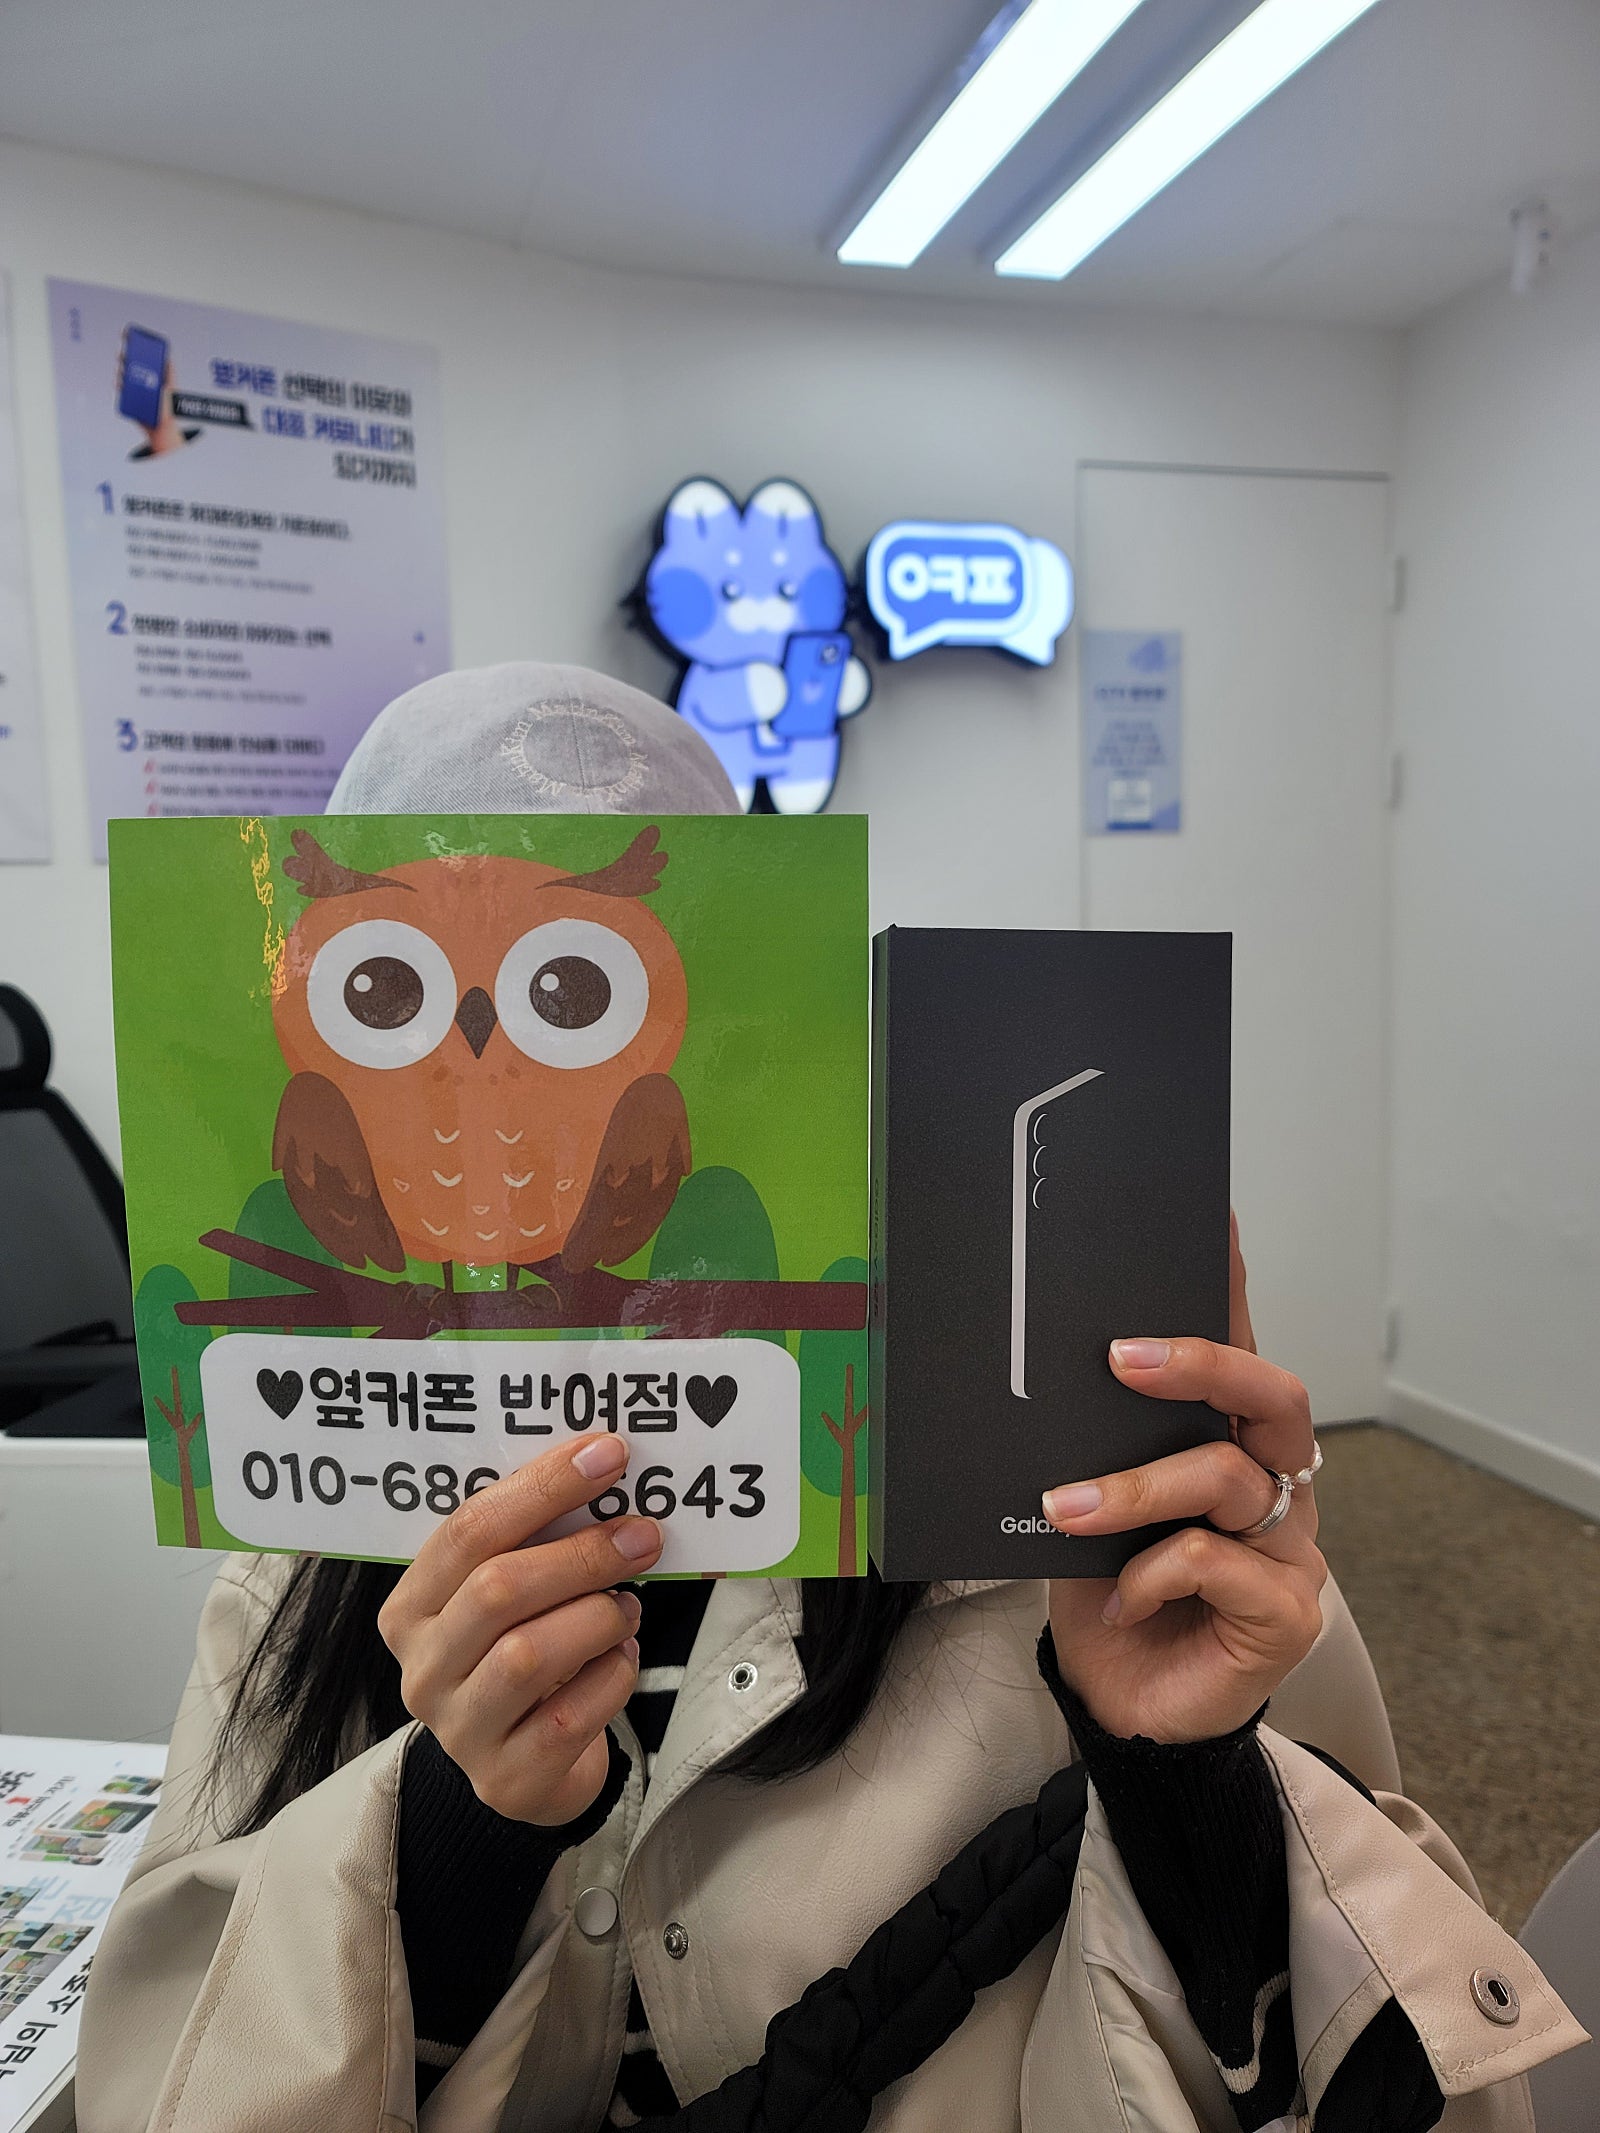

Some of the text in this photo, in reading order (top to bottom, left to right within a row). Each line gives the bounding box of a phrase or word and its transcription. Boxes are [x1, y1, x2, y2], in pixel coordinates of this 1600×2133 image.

[106, 601, 128, 635] 2
[115, 718, 138, 752] 3
[309, 1366, 679, 1435] 옆커폰 반여점
[1000, 1516, 1071, 1538] Gala
